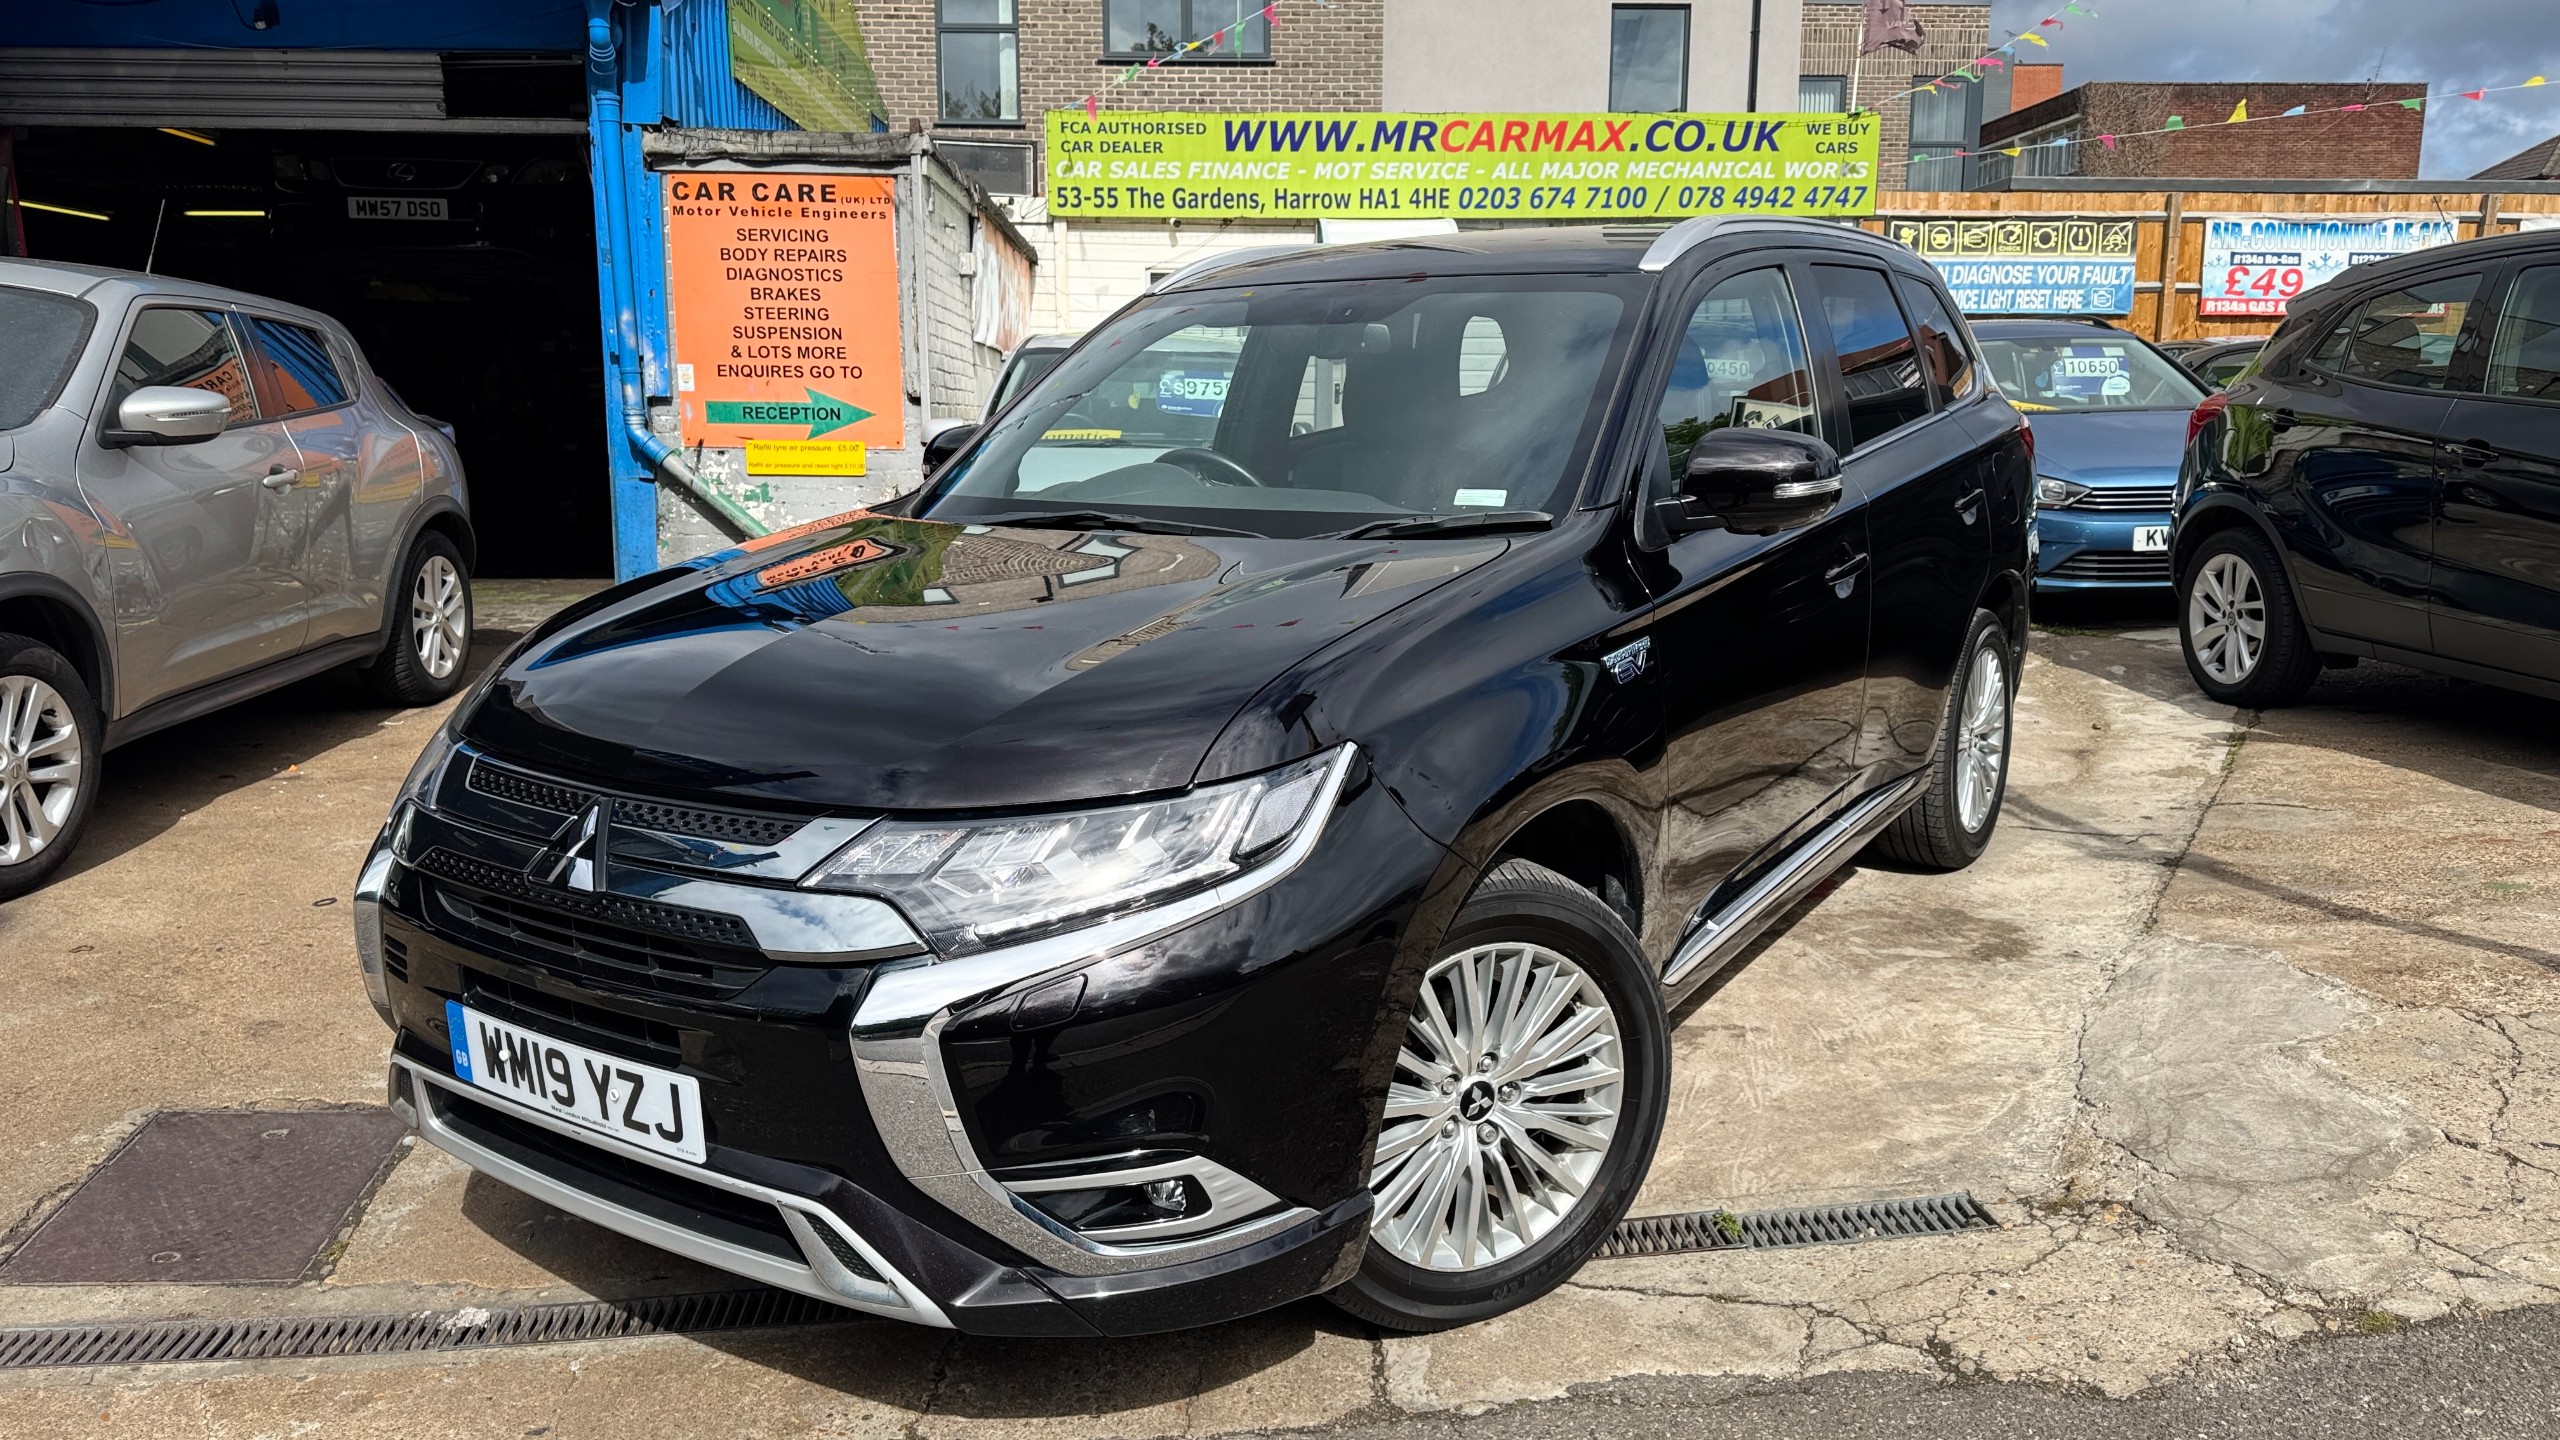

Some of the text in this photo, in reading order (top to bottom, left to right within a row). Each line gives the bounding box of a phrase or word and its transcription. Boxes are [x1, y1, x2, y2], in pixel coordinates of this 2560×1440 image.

[1060, 121, 1207, 136] FCA AUTHORISED
[1223, 119, 1786, 153] WWW.MRCARMAX.CO.UK
[1807, 123, 1871, 136] WE BUY
[1060, 140, 1164, 154] CAR DEALER
[1815, 142, 1858, 154] CARS
[1056, 161, 1105, 179] CAR
[1110, 161, 1181, 179] SALES
[1188, 162, 1290, 180] FINANCE
[1314, 162, 1369, 180] MOT
[1370, 161, 1469, 180] SERVICE
[1492, 162, 1532, 179] ALL
[1540, 162, 1621, 179] MAJOR
[1626, 162, 1775, 179] MECHANICAL
[1784, 161, 1868, 179] WORKS
[671, 181, 891, 206] CAR CARE (UK) LTD
[1056, 186, 1119, 208] 53-55
[1126, 187, 1165, 208] The
[1172, 187, 1266, 214] Gardens,
[1274, 188, 1351, 209] Harrow
[1360, 188, 1400, 209] HA1
[1409, 188, 1450, 209] 4HE
[1458, 186, 1520, 209] 0203
[1530, 186, 1576, 209] 674
[1585, 186, 1647, 209] 7100
[1678, 186, 1726, 208] 078
[1733, 186, 1795, 208] 4942
[1804, 186, 1868, 208] 4747
[356, 200, 401, 217] MW57
[672, 205, 887, 221] Motor Vehicle Engineers
[736, 228, 829, 243] SERVICING
[2210, 222, 2387, 250] AIR-CONDITIONING
[720, 248, 847, 263] BODY REPAIRS
[726, 267, 844, 282] DIAGNOSTICS
[1952, 265, 2034, 286] DIAGNOSE
[2037, 265, 2080, 285] YOUR
[2224, 265, 2304, 297] £49
[750, 287, 821, 301] BRAKES
[1980, 289, 2015, 310] LIGHT
[2016, 289, 2052, 310] RESET
[2053, 289, 2084, 310] HERE
[2206, 300, 2247, 312] R134a
[2249, 301, 2275, 312] GAS
[743, 307, 830, 321] STEERING
[732, 326, 843, 341] SUSPENSION
[731, 345, 847, 360] & LOTS MORE
[717, 365, 863, 380] ENQUIRES GO TO
[2068, 360, 2118, 374] 10650
[742, 406, 842, 421] RECEPTION
[753, 443, 772, 451] Refill
[773, 444, 788, 452] tyre
[455, 1049, 468, 1067] GB
[479, 1021, 684, 1144] WM19 YZJ
